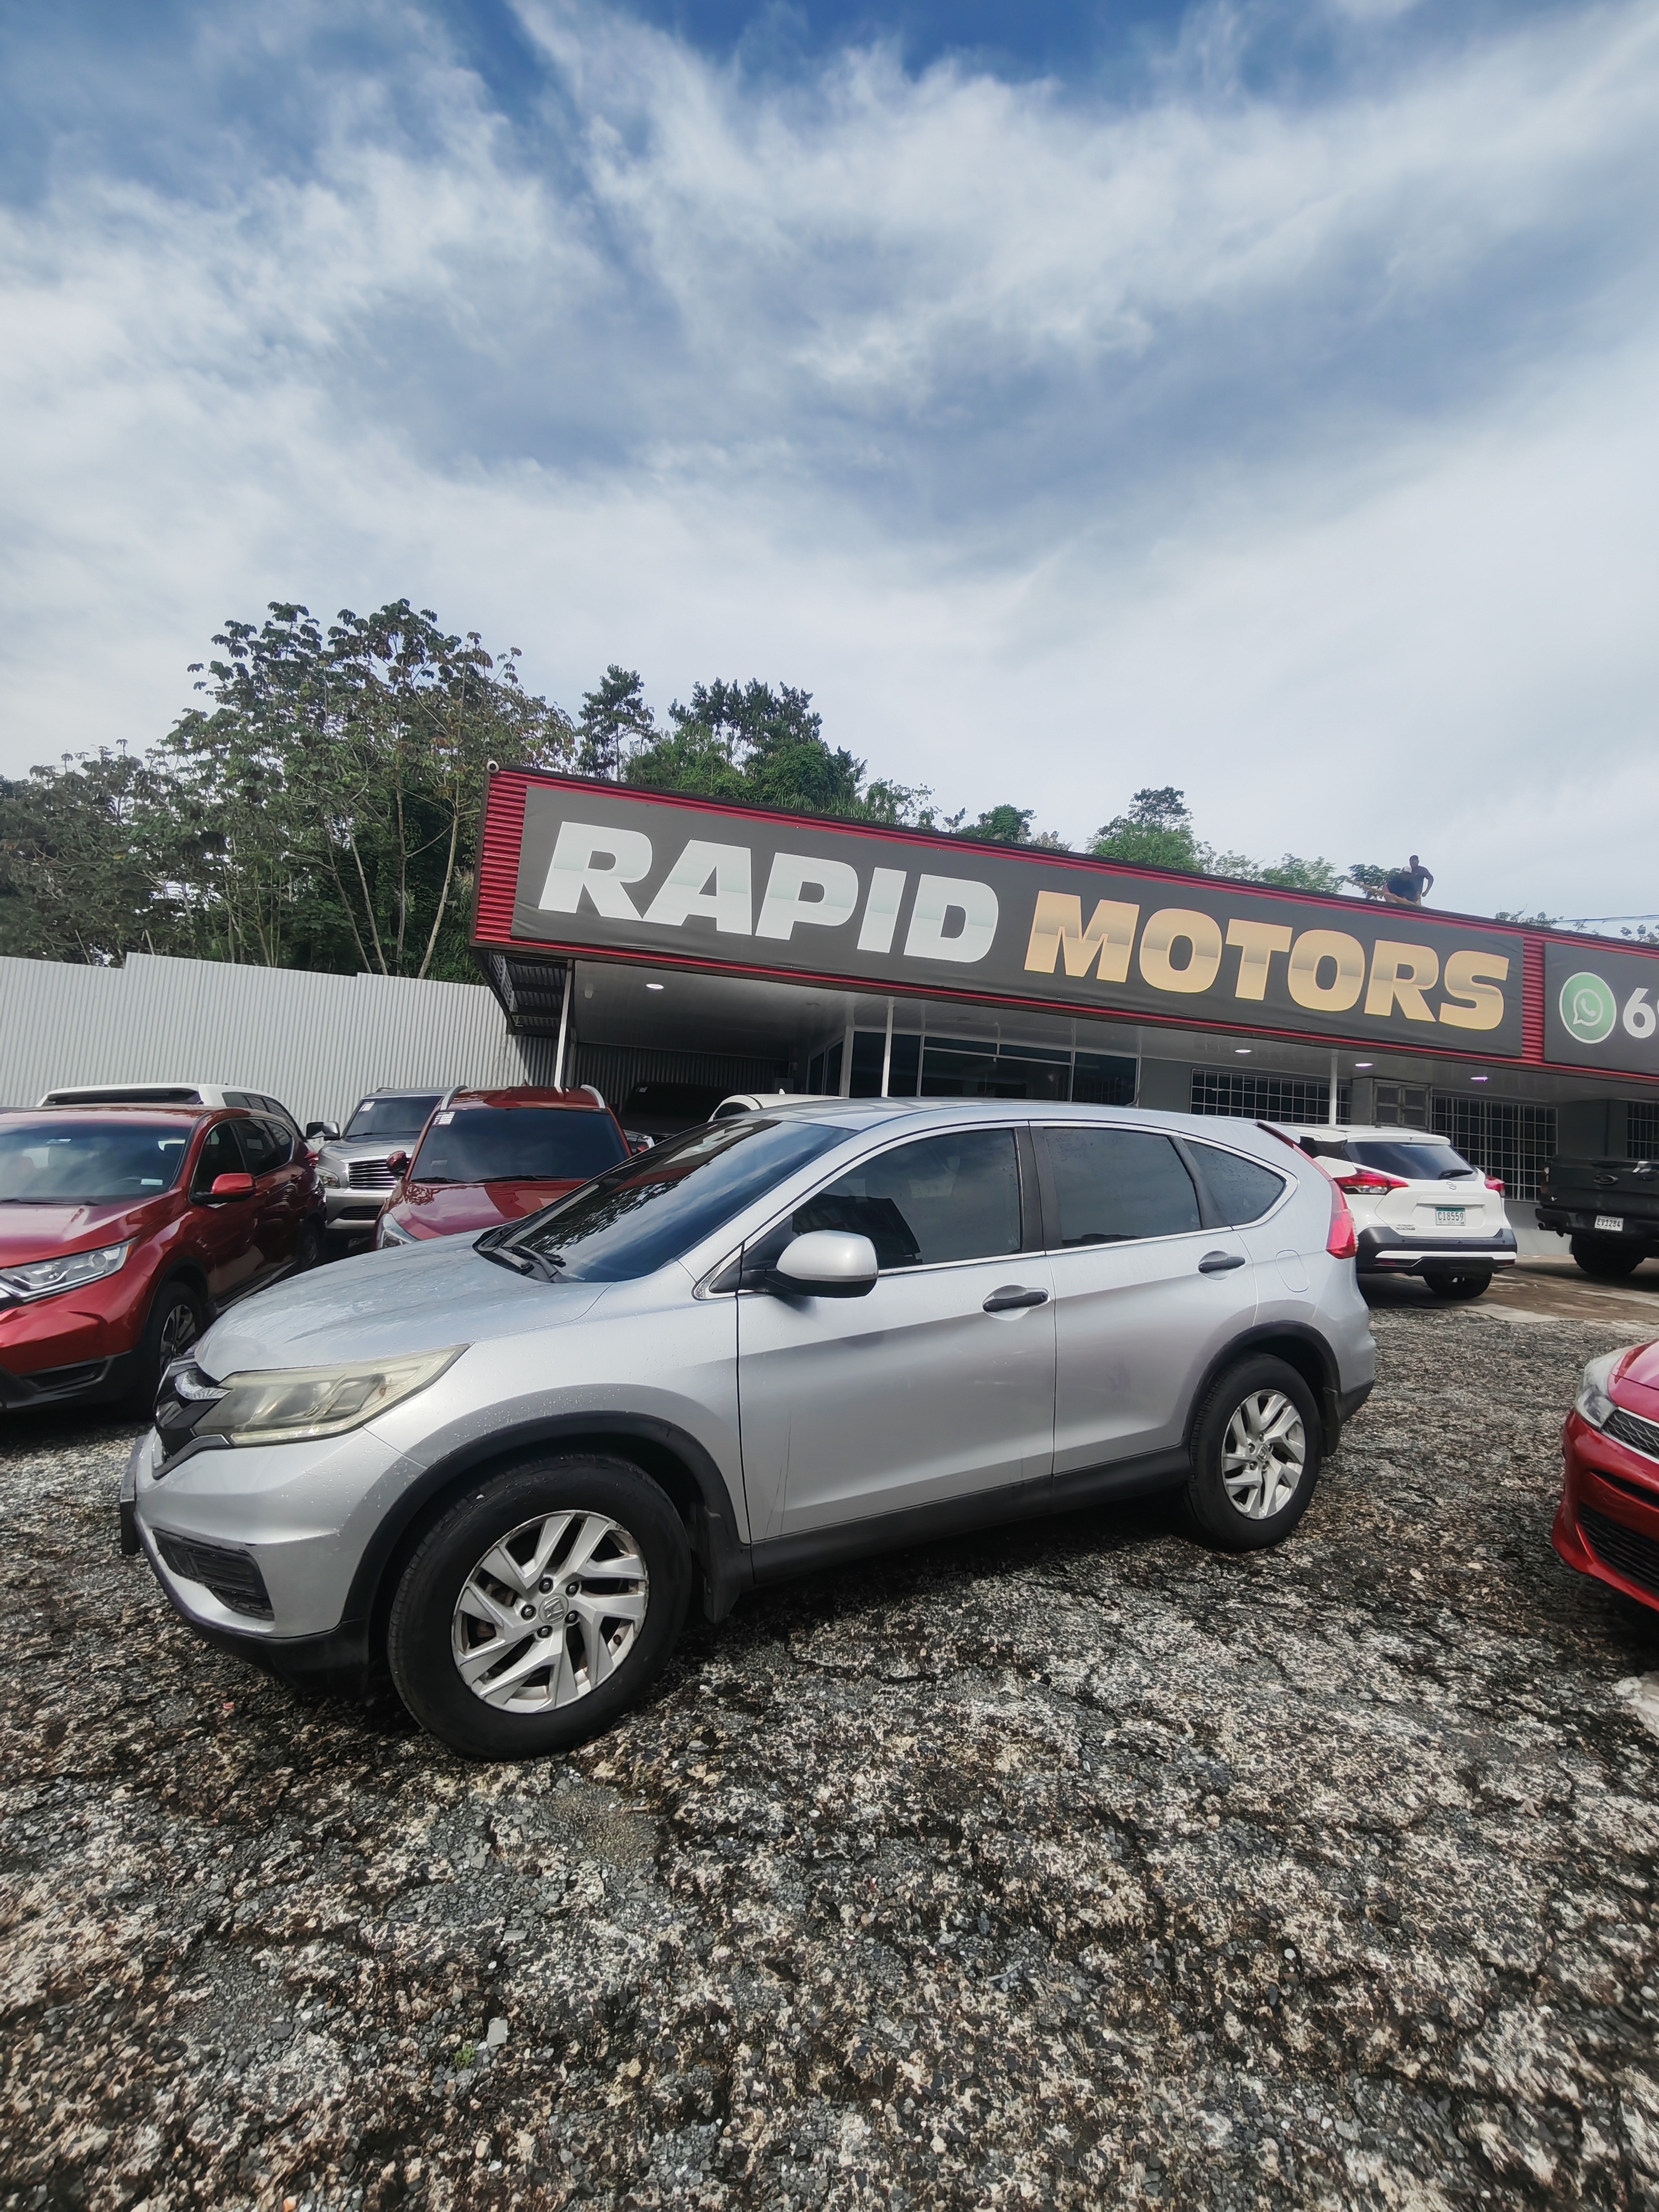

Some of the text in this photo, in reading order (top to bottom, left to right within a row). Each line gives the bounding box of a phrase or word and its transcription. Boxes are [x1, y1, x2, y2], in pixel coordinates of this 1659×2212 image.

[538, 821, 1510, 1030] RAPID MOTORS
[1623, 987, 1659, 1038] 6
[1438, 1212, 1464, 1221] CI8559
